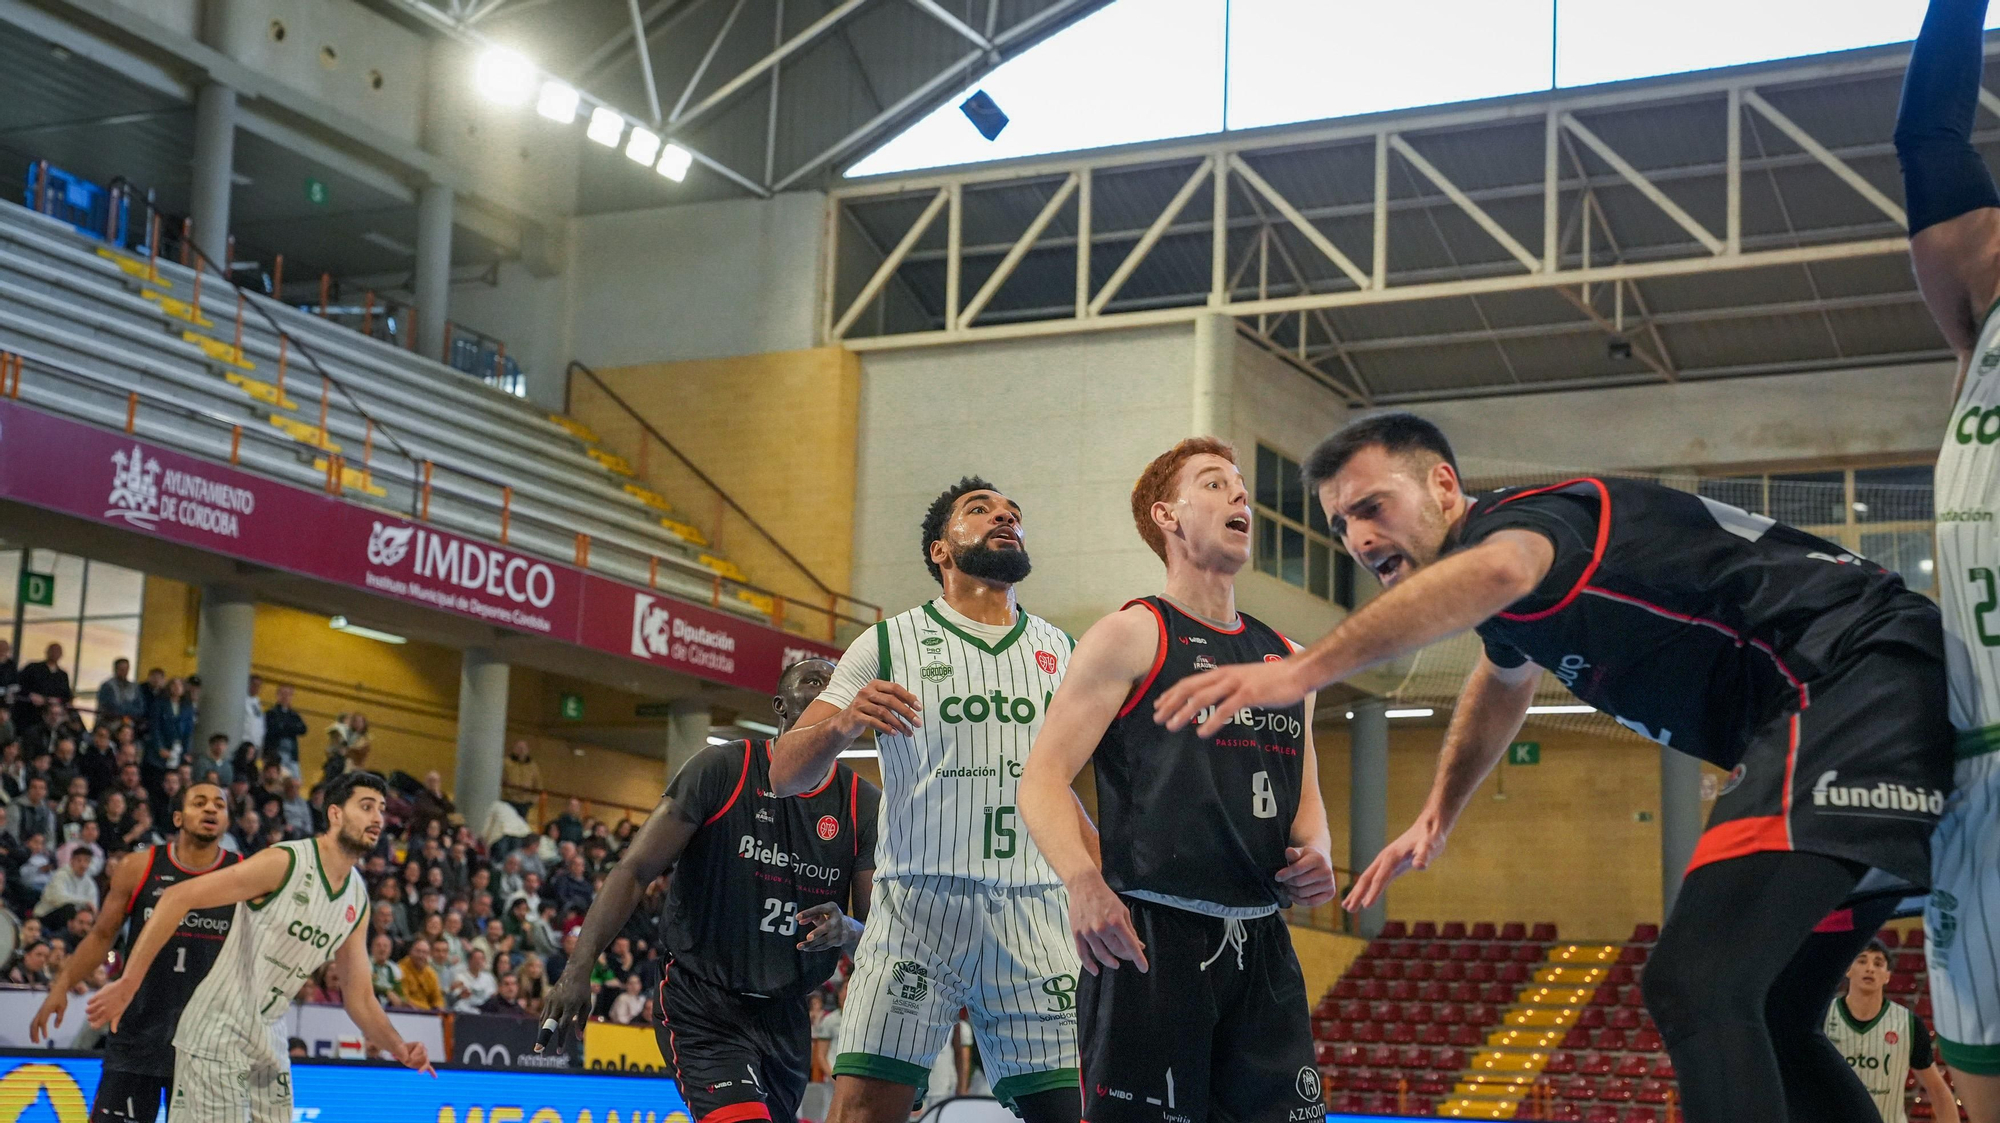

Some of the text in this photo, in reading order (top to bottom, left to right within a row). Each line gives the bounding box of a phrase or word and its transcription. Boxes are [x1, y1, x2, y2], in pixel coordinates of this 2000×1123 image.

[159, 494, 178, 521] DE
[161, 468, 255, 515] AYUNTAMIENTO
[413, 529, 555, 609] IMDECO
[29, 576, 46, 601] D
[672, 617, 735, 653] Diputación
[940, 690, 1036, 724] coto
[1516, 744, 1531, 763] K
[935, 766, 996, 779] Fundación
[1252, 770, 1278, 819] 8
[1812, 769, 1945, 816] fundibid
[983, 806, 1017, 860] 15
[759, 898, 798, 937] 23
[173, 947, 187, 973] 1
